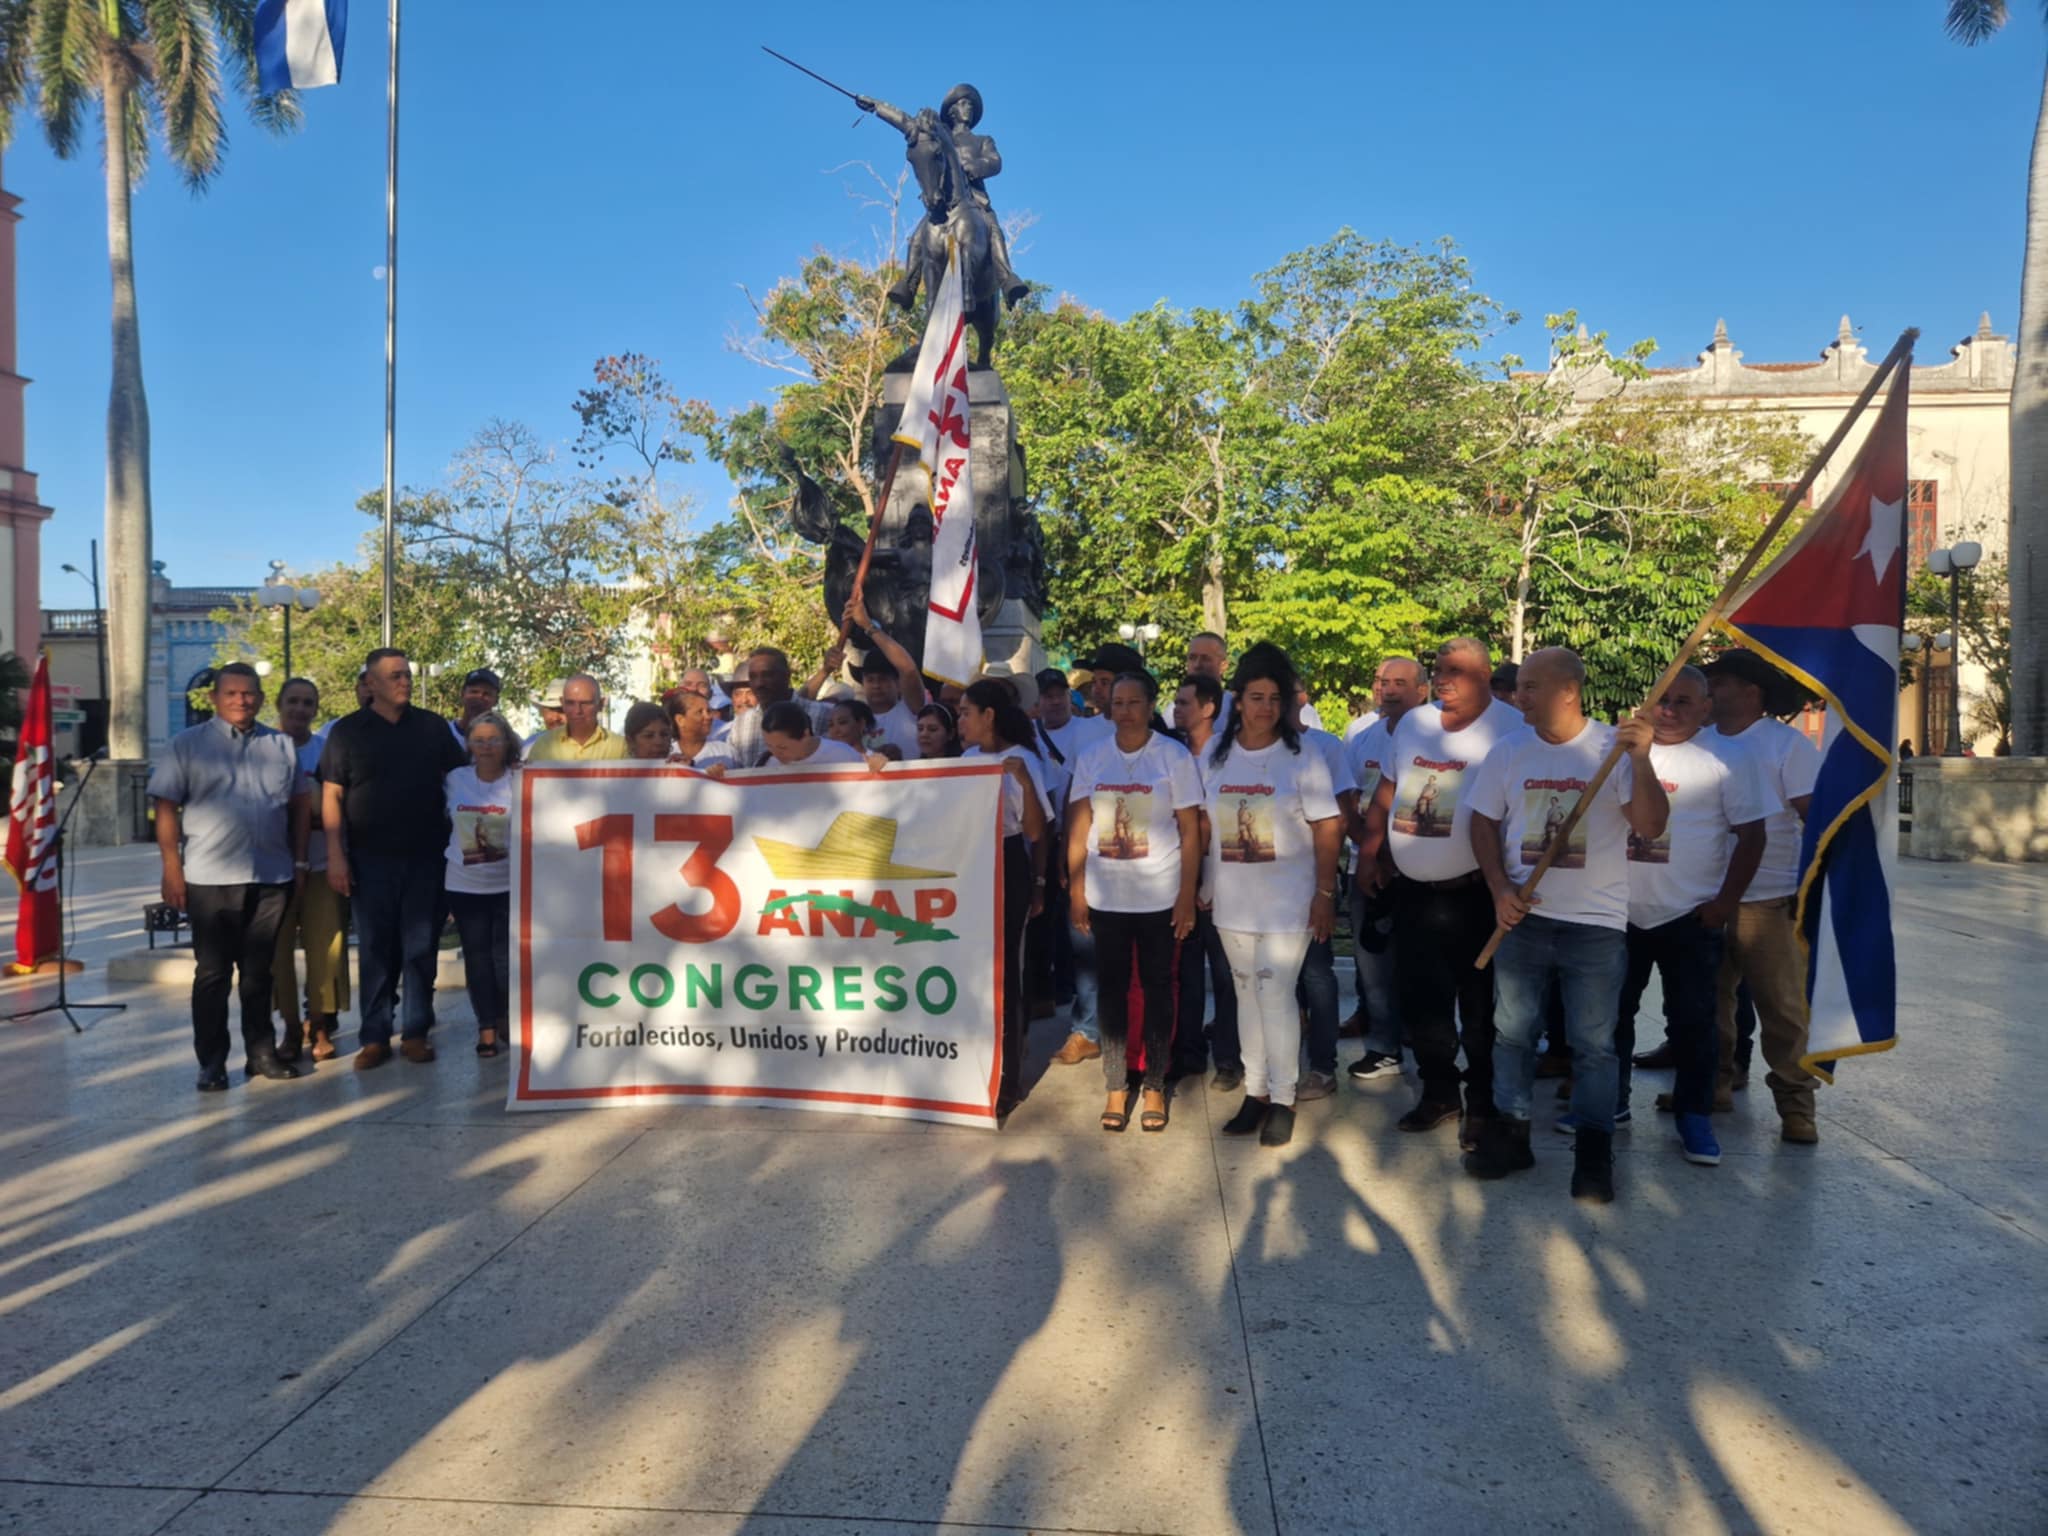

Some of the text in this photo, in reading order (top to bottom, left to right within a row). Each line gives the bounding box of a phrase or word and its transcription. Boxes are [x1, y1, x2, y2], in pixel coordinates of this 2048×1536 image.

[575, 813, 742, 944] 13
[757, 888, 957, 940] ANAP
[577, 962, 957, 1015] CONGRESO
[576, 1021, 959, 1060] Fortalecidos, Unidos y Productivos
